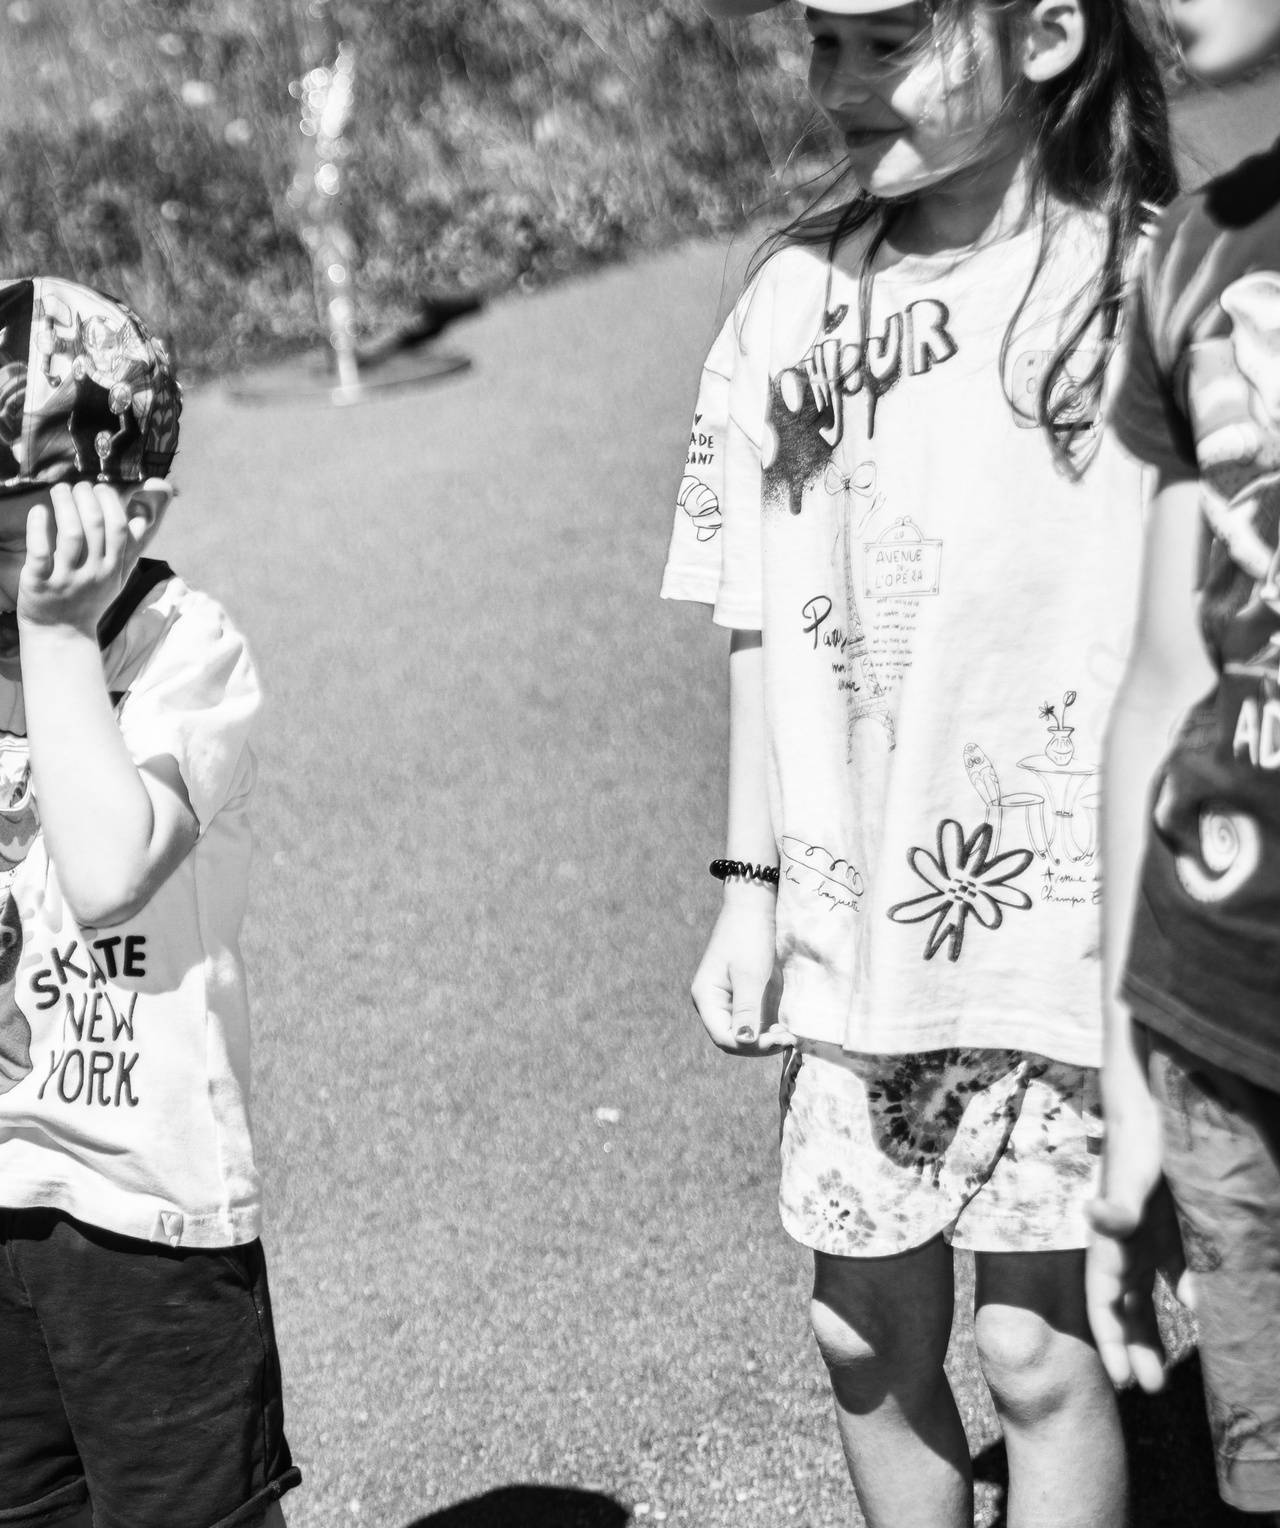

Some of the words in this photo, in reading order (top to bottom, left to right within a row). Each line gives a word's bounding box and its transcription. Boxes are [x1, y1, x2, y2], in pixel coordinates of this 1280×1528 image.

[875, 549, 922, 565] AVENUE
[875, 567, 923, 589] L'OPÉRA
[29, 935, 146, 1011] SKATE
[63, 992, 138, 1043] NEW
[37, 1048, 140, 1108] YORK
